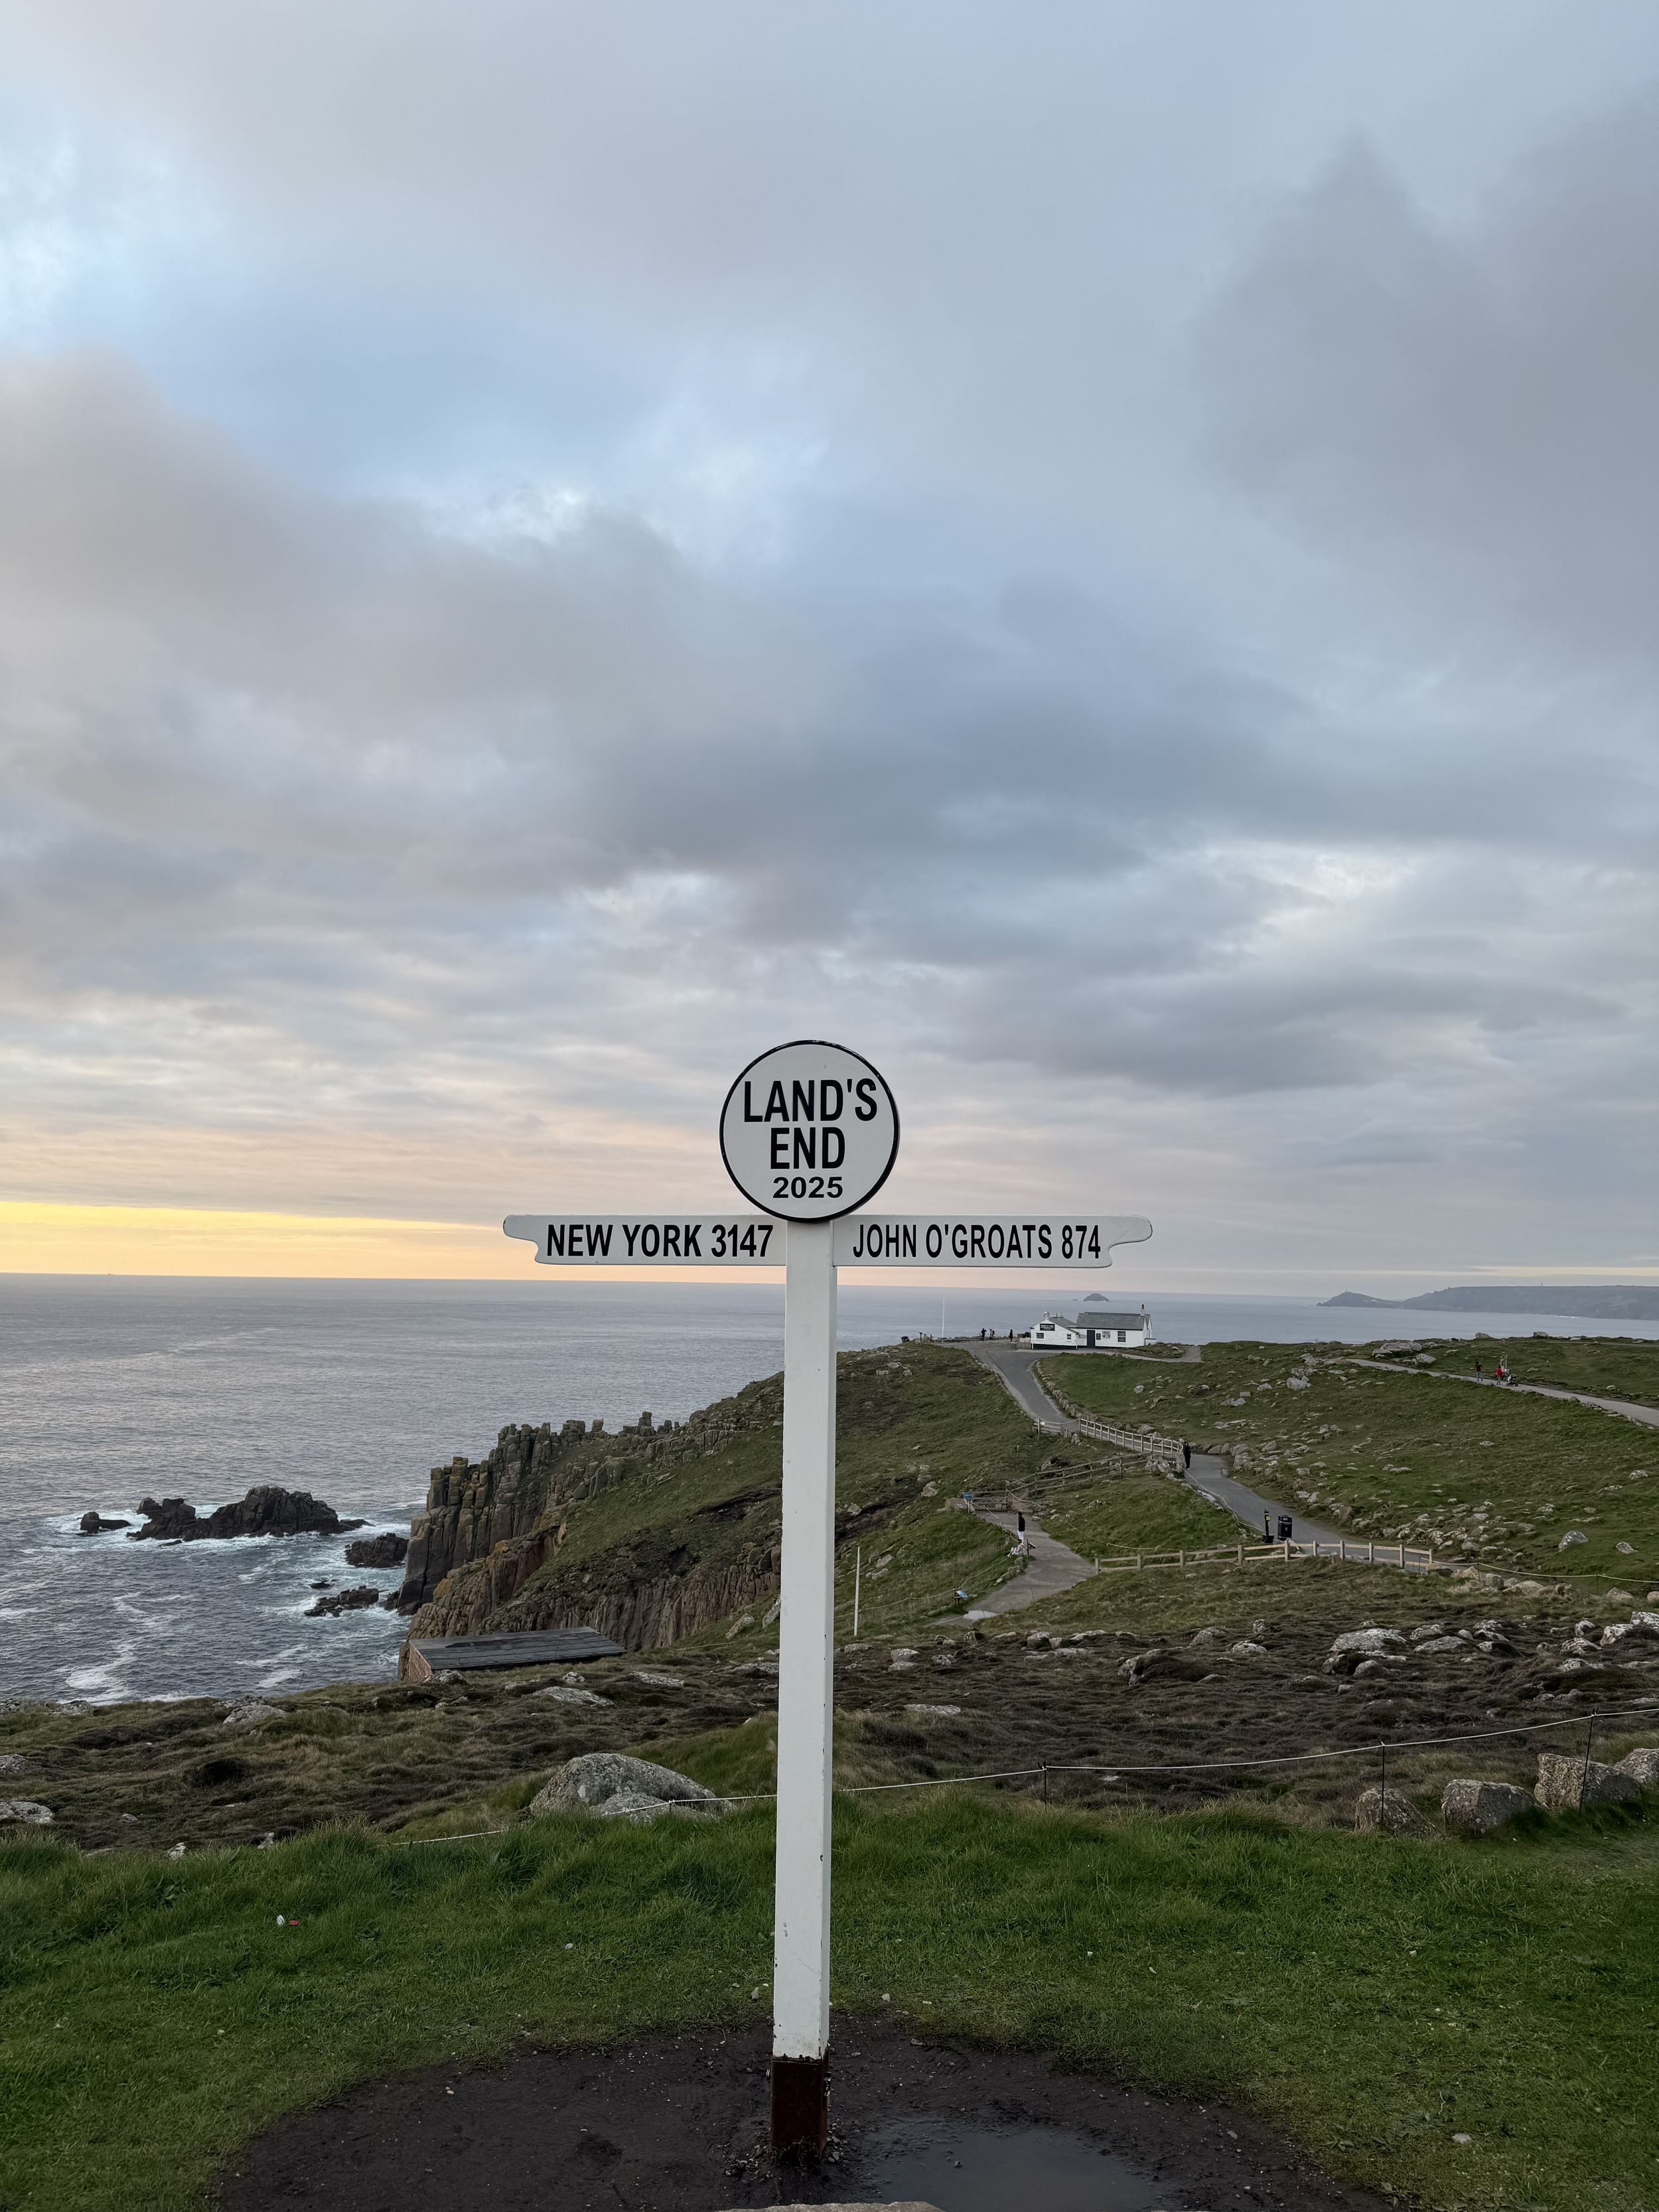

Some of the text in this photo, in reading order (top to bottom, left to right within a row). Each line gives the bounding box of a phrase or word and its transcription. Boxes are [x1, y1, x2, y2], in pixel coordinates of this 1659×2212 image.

[744, 1078, 877, 1123] LAND'S
[770, 1126, 845, 1169] END
[772, 1176, 843, 1199] 2025
[547, 1224, 774, 1258] NEW YORK 3147
[853, 1224, 1101, 1260] JOHN O'GROATS 874
